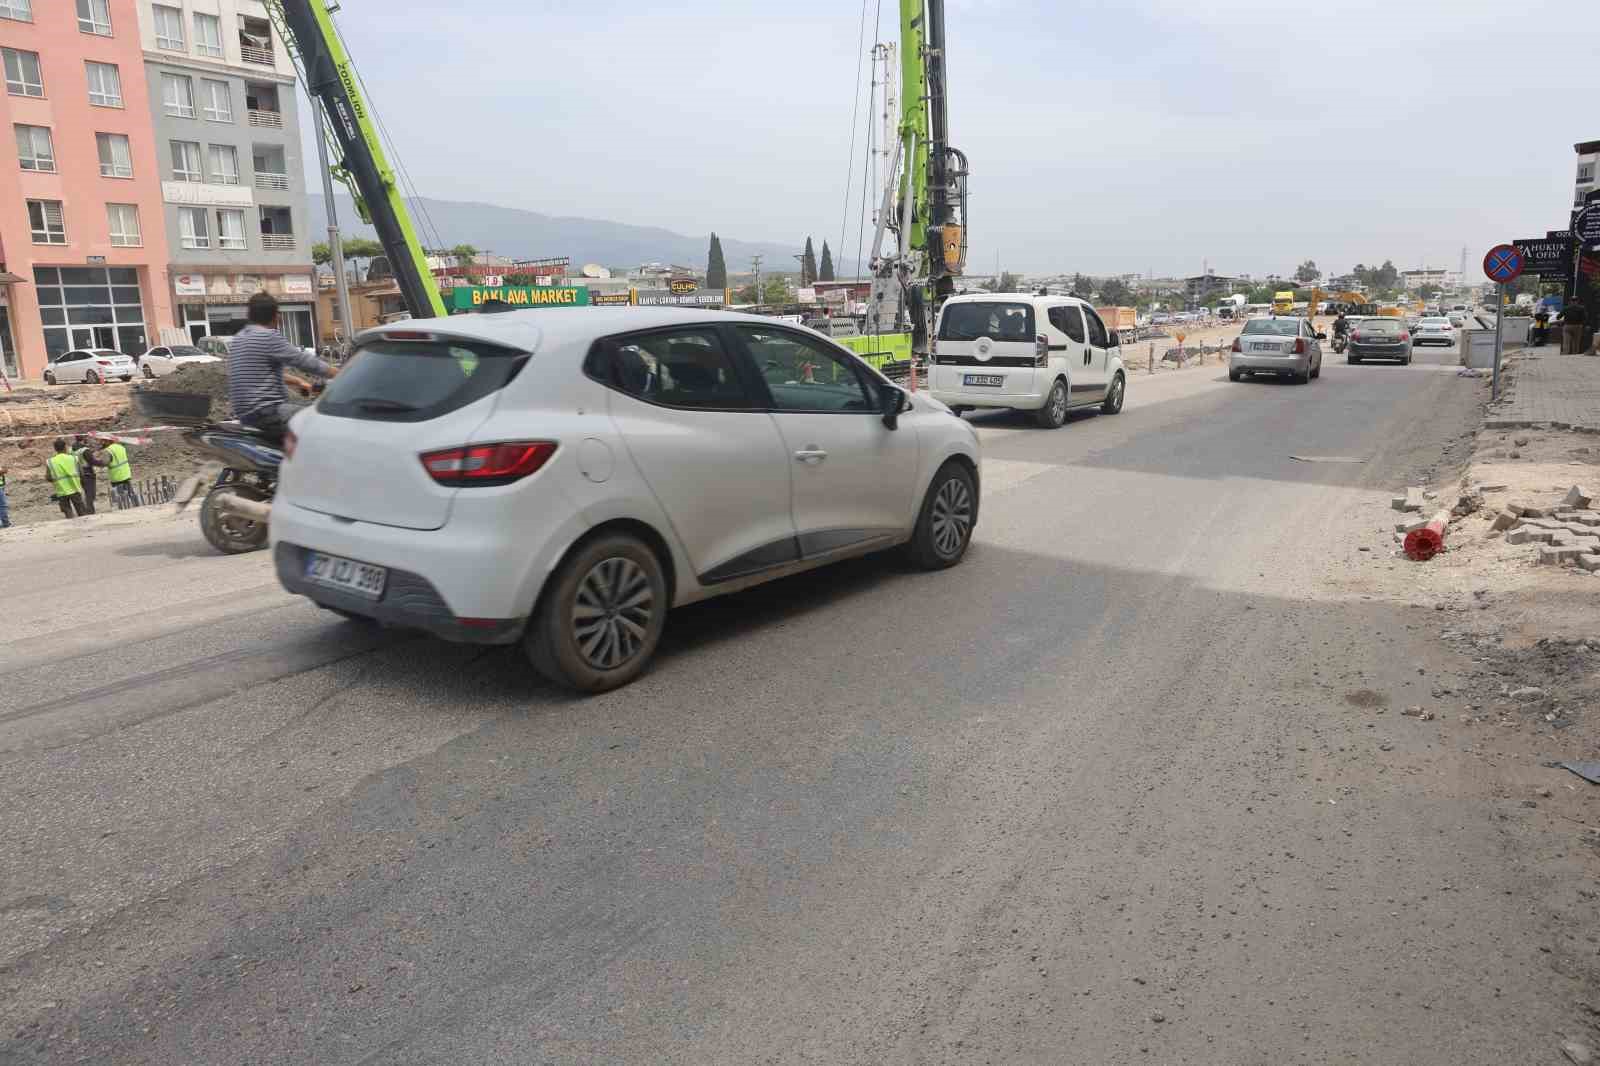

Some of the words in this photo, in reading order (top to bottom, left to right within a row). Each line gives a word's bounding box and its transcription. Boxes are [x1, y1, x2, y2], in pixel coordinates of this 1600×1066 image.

[338, 64, 365, 119] ZOOMLION
[1531, 243, 1566, 251] HUKUK
[472, 288, 528, 304] BAKLAVA
[531, 289, 577, 304] MARKET
